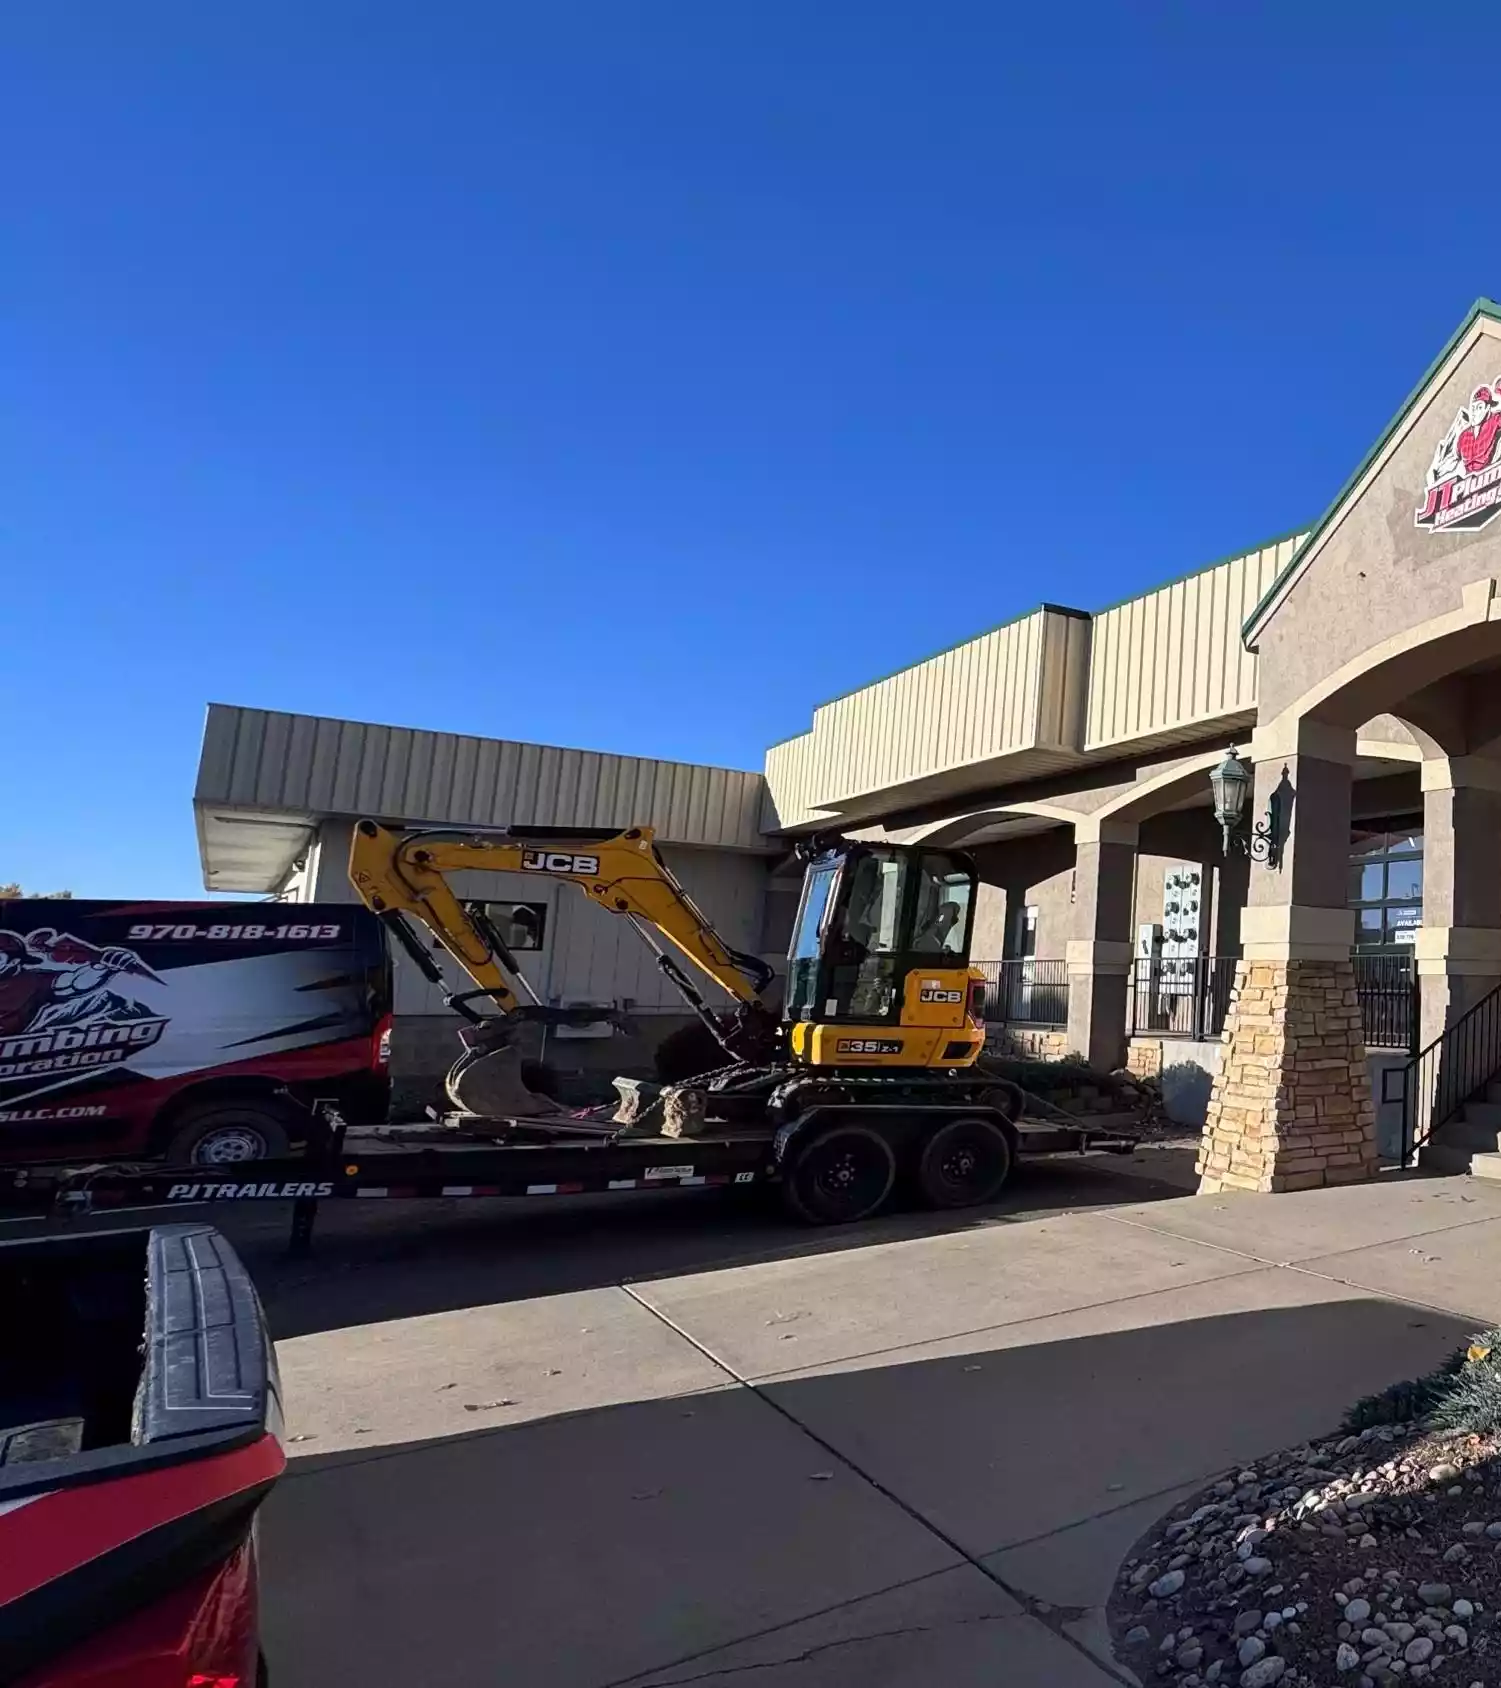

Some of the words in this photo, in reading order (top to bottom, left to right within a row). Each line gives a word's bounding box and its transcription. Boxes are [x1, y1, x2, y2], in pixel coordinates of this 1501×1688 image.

[1418, 478, 1456, 520] JT
[1435, 488, 1498, 527] Heating
[523, 852, 598, 874] JCB
[127, 925, 341, 940] 970-818-1613
[921, 990, 961, 1002] JCB
[0, 1022, 164, 1058] mbing
[850, 1041, 877, 1052] 35
[166, 1184, 201, 1199] PJ
[202, 1182, 335, 1198] TRAILERS
